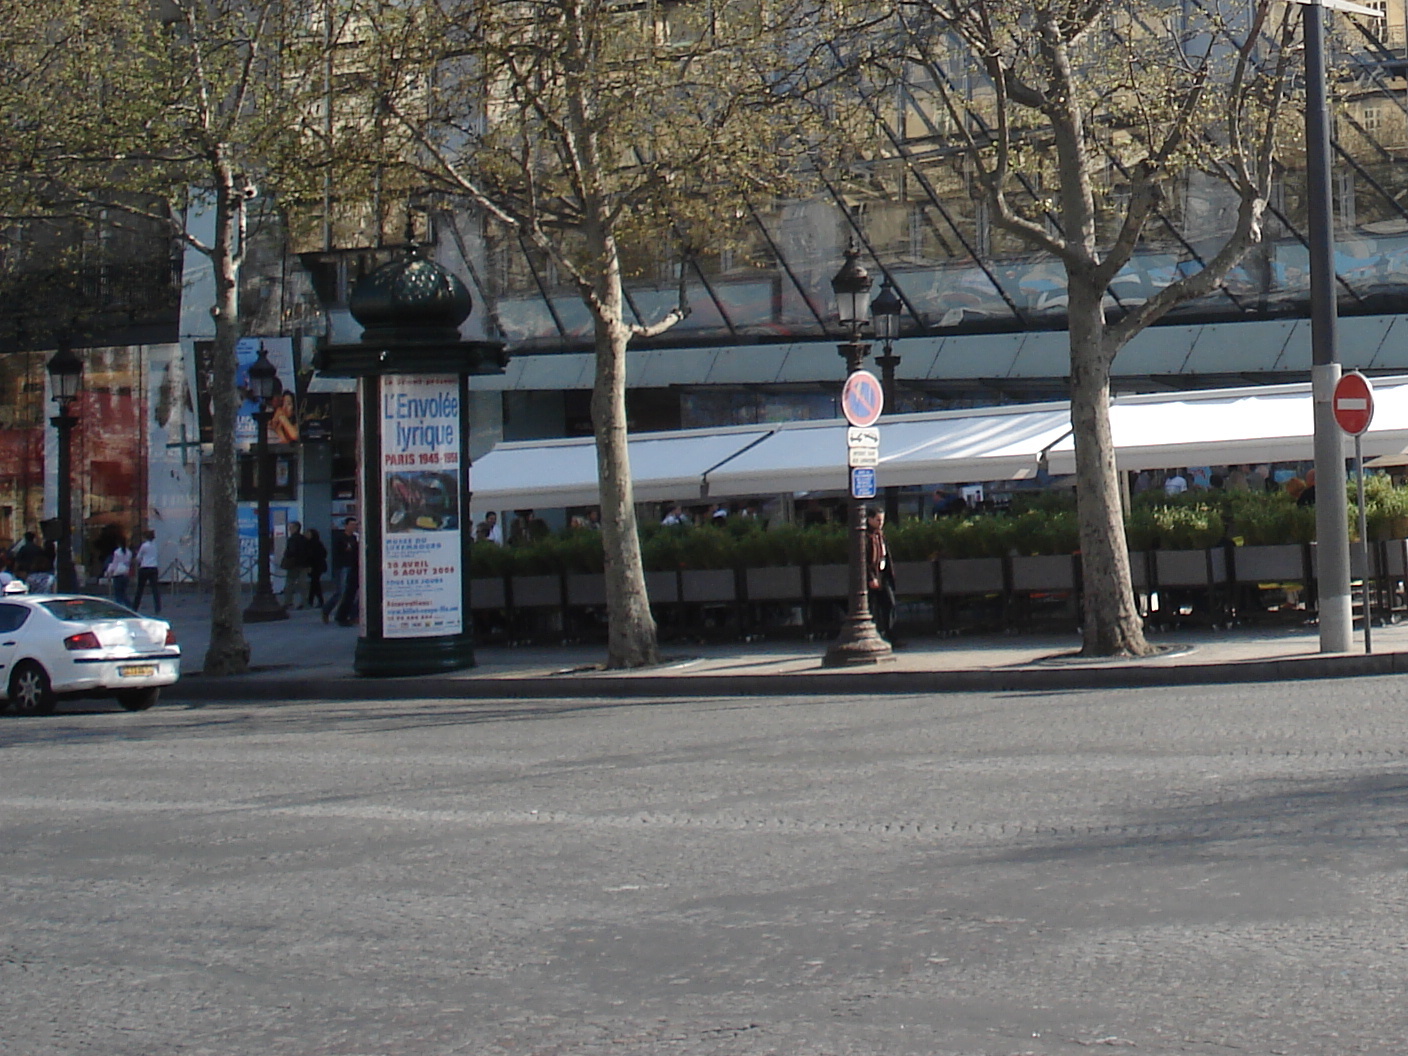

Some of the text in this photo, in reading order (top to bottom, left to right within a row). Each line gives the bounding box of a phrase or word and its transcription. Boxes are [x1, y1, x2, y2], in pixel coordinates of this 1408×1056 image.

[384, 392, 458, 420] L'Envolée
[396, 420, 454, 452] lyrique
[384, 453, 415, 466] PARIS
[401, 560, 429, 568] AVRIL
